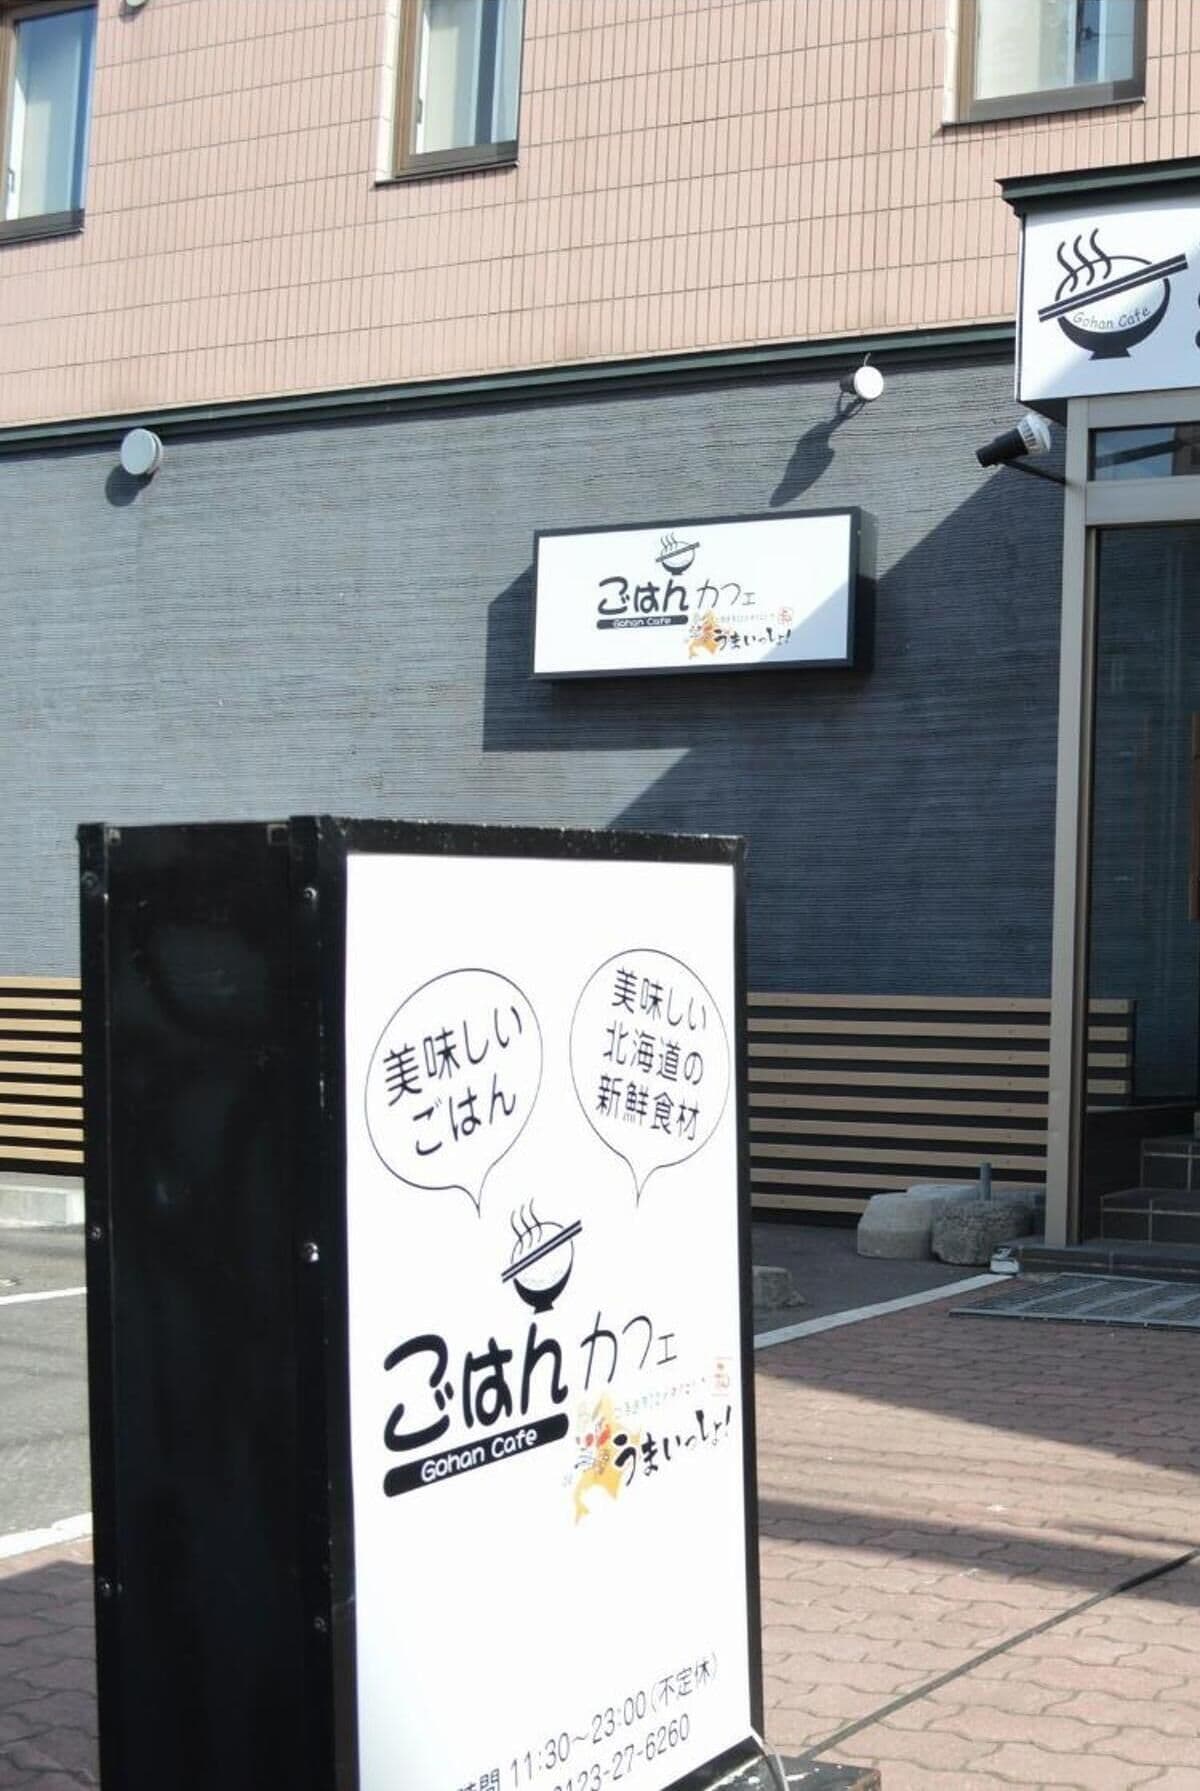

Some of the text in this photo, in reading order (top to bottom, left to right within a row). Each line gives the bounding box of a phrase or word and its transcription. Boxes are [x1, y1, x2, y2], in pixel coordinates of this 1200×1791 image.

[1072, 306, 1151, 330] Gohan Cafe
[611, 966, 707, 1031] 美味しい
[383, 1005, 523, 1107] 美味しい
[602, 1020, 705, 1087] 北海道の
[412, 1071, 517, 1157] ごはん
[595, 1074, 701, 1142] 新鮮食材
[420, 1427, 539, 1484] Gohan Cafe
[552, 1713, 690, 1791] 23-27-6260
